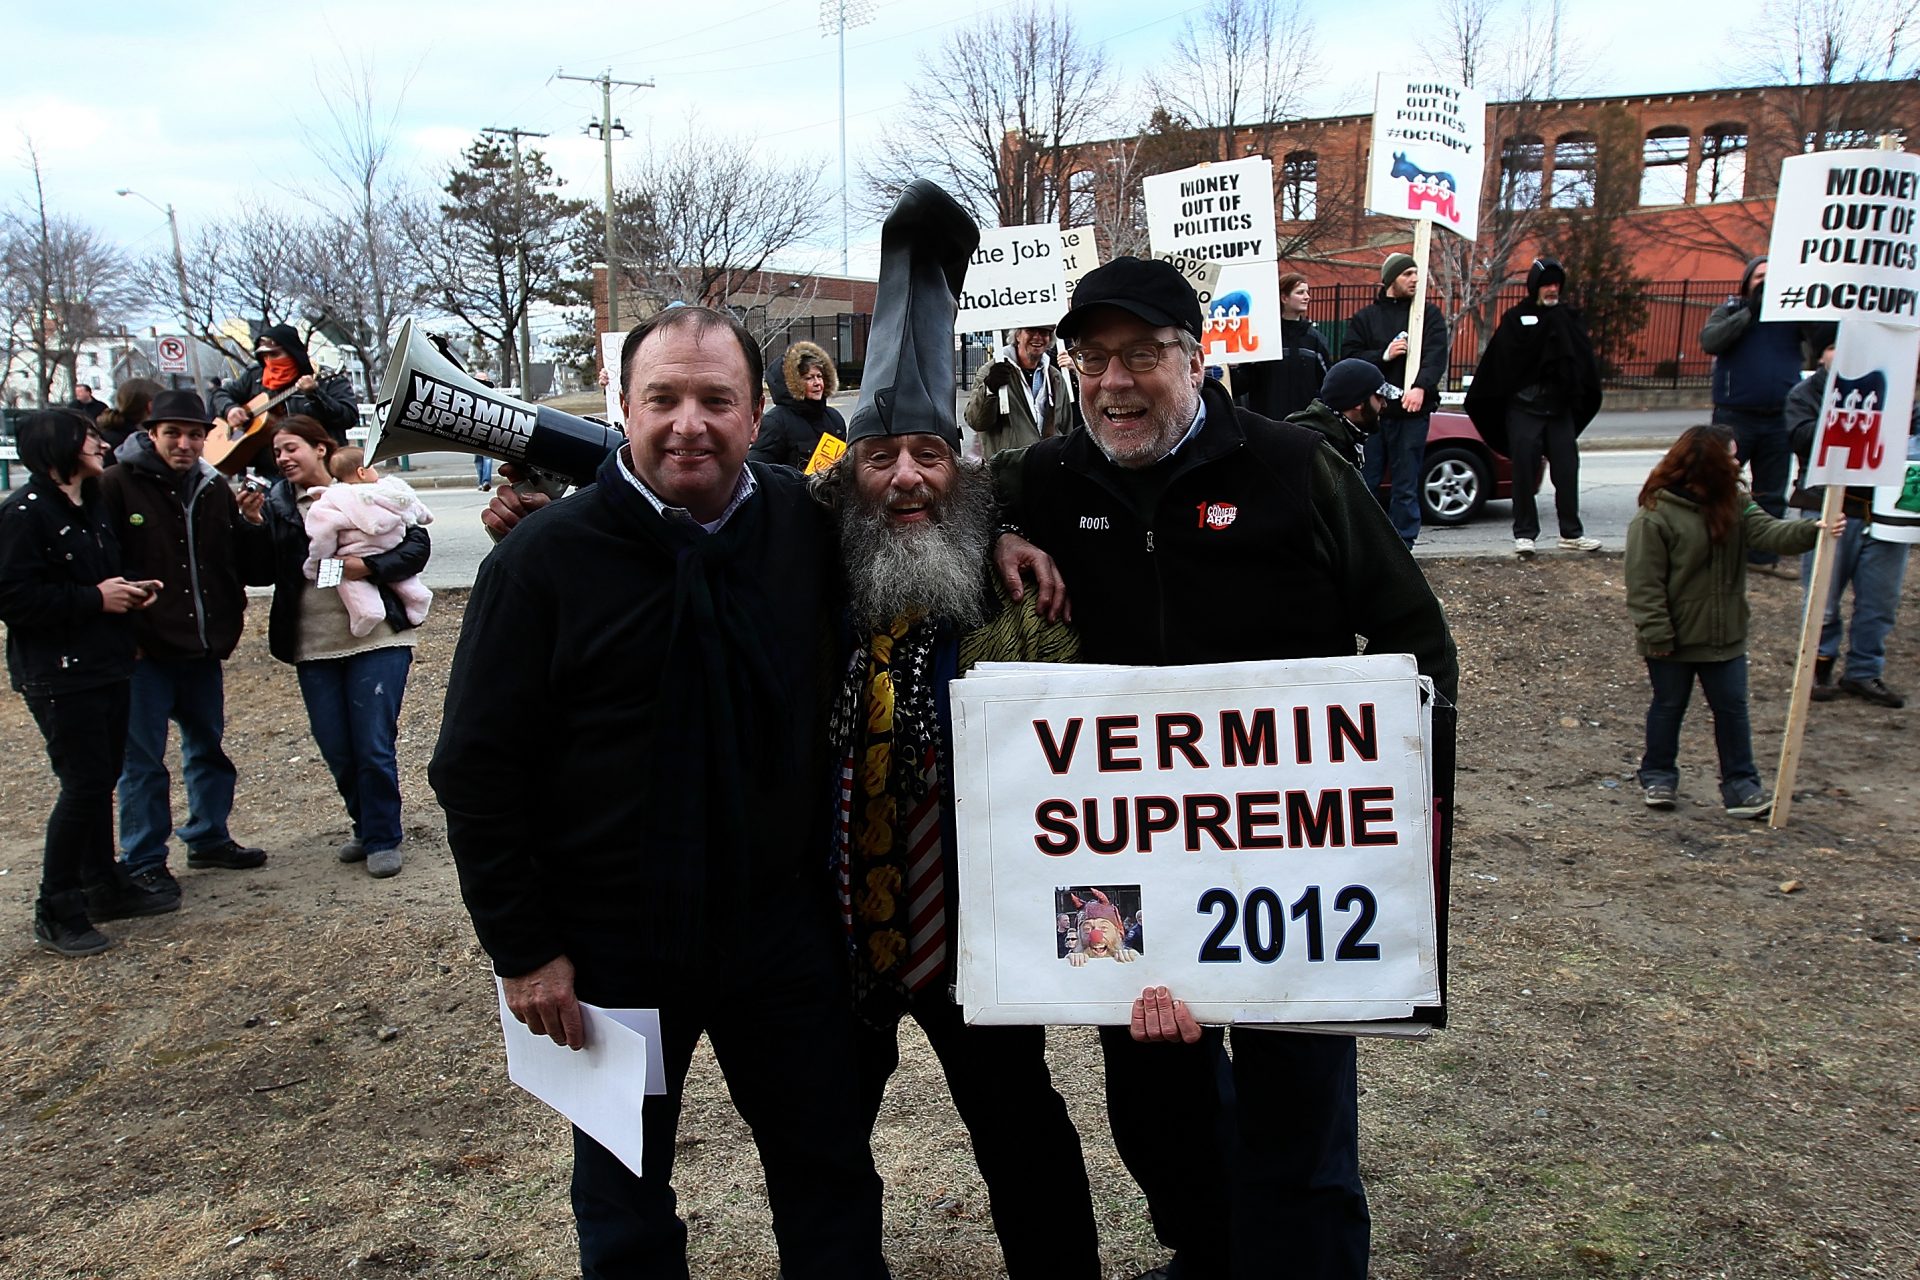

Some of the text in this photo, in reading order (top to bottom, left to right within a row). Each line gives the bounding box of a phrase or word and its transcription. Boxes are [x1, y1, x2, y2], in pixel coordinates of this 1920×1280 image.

[1407, 82, 1461, 100] MONEY
[1406, 97, 1461, 115] OUT OF
[1397, 110, 1466, 133] POLITICS
[1387, 128, 1472, 154] #OCCUPY
[1180, 174, 1240, 198] MONEY
[1826, 167, 1919, 200] MONEY
[1182, 195, 1241, 218] OUT OF
[1822, 203, 1916, 235] OUT OF
[1174, 213, 1252, 238] POLITICS
[1012, 239, 1051, 265] Job
[1170, 240, 1262, 261] OCCUPY
[1800, 237, 1918, 271] POLITICS
[1780, 282, 1919, 316] #OCCUPY
[414, 374, 536, 437] VERMIN
[406, 400, 530, 453] SUPREME
[1079, 516, 1110, 530] ROOTS
[1207, 505, 1238, 517] COMEDY
[1032, 702, 1379, 775] VERMIN
[1033, 786, 1400, 858] SUPREME
[1196, 883, 1382, 965] 2012
